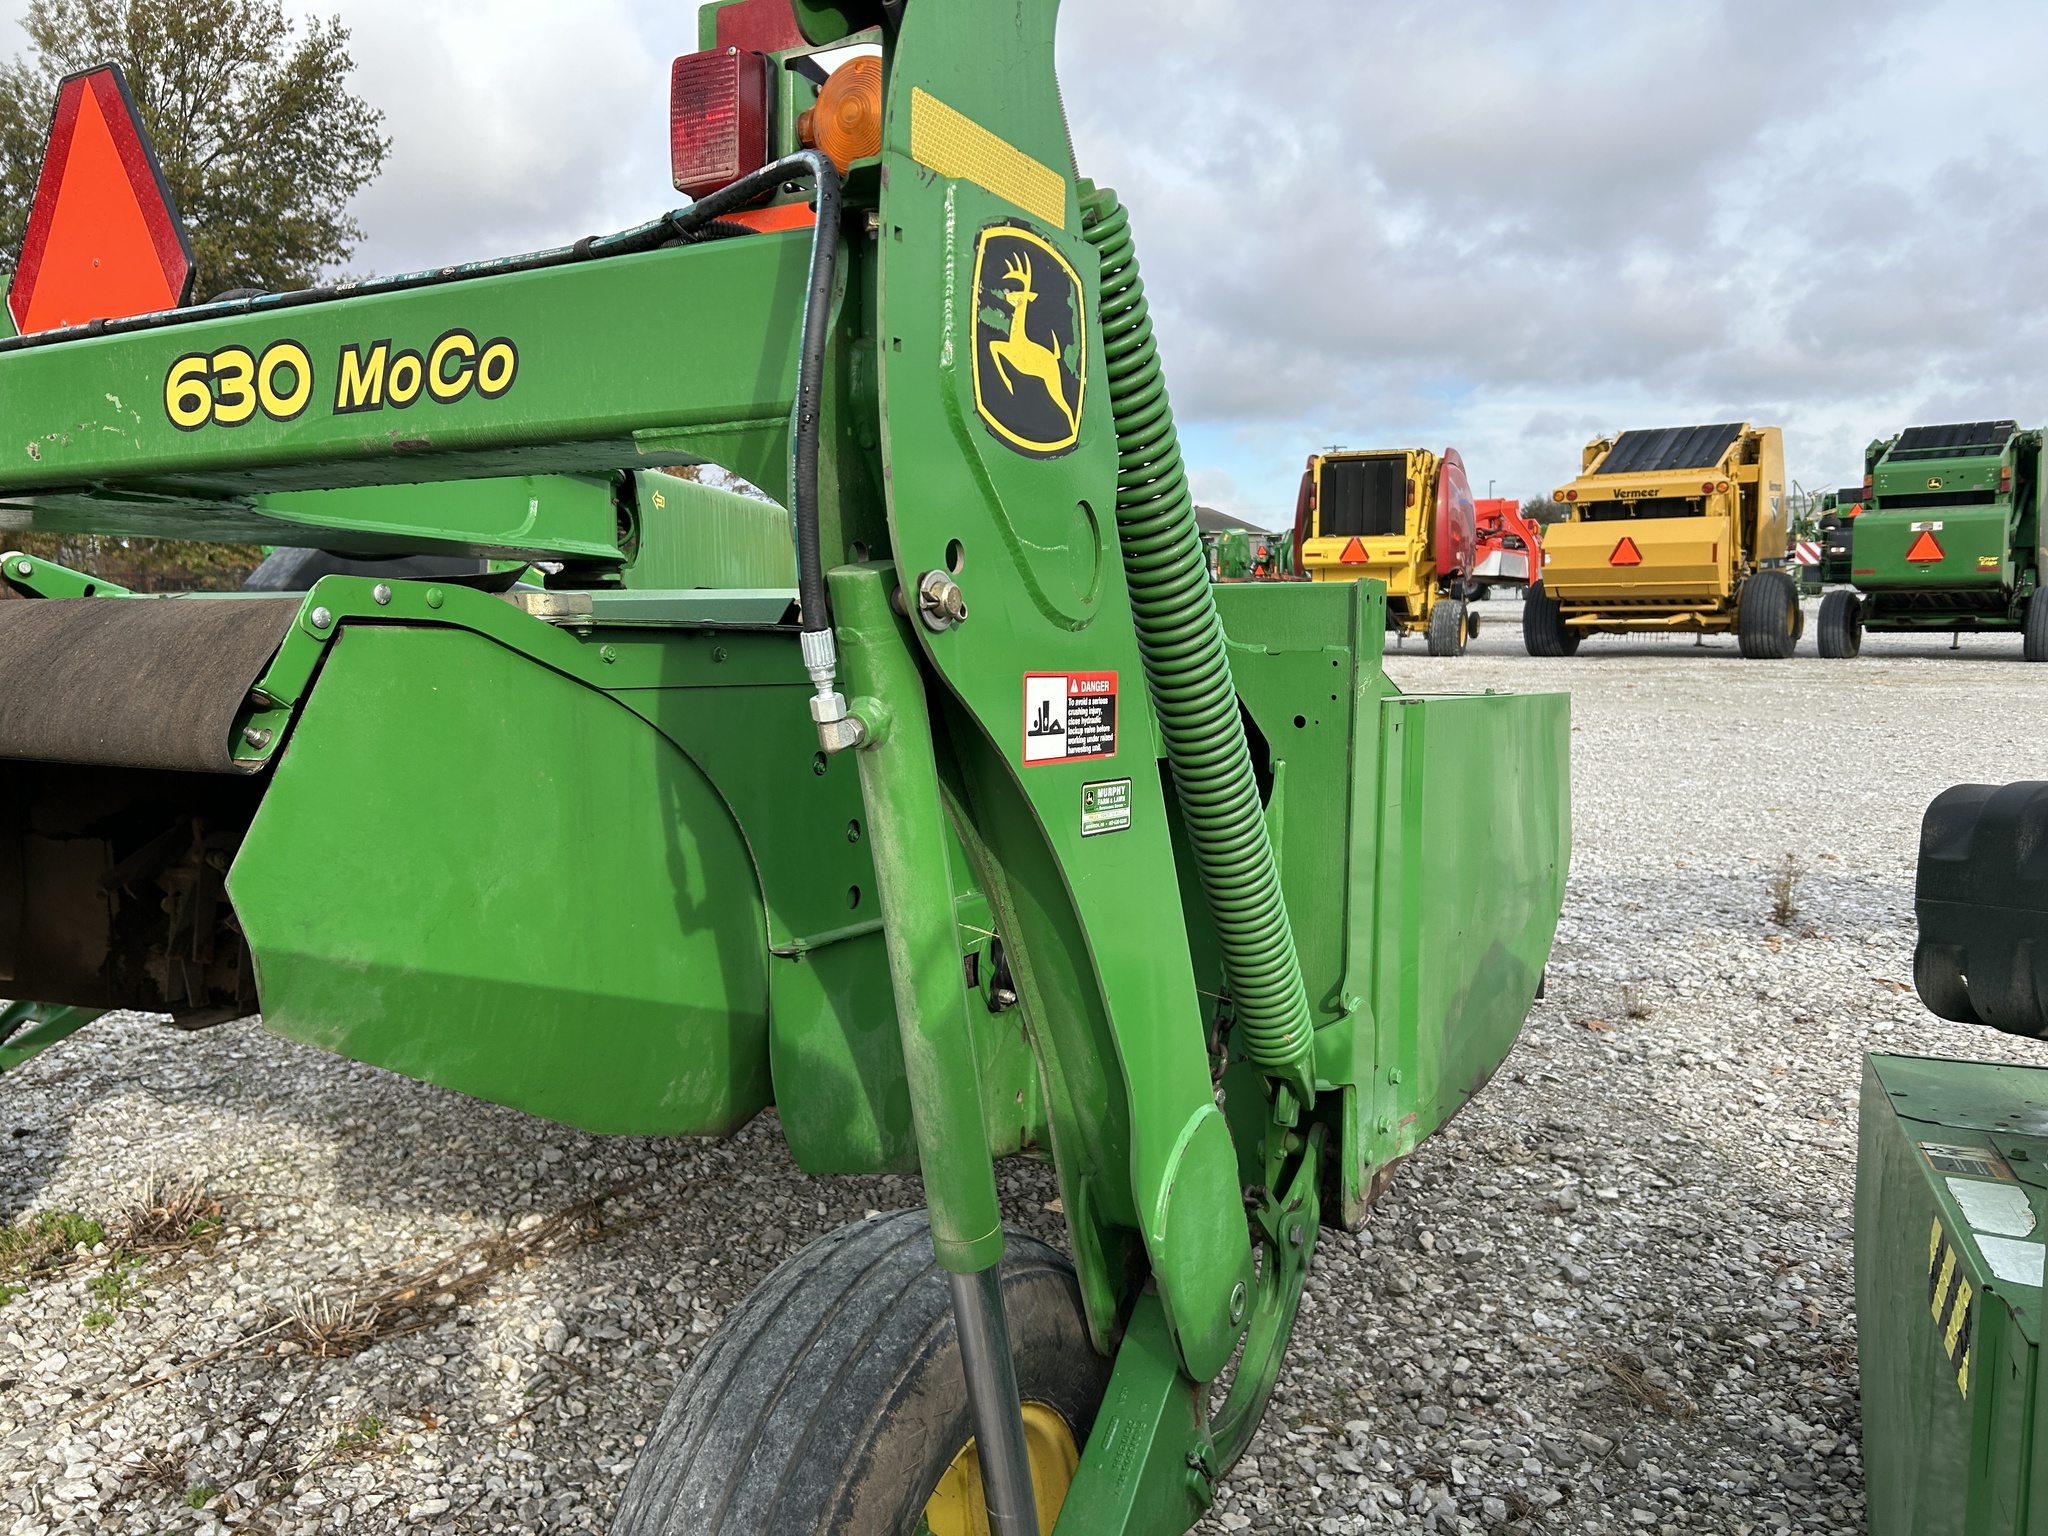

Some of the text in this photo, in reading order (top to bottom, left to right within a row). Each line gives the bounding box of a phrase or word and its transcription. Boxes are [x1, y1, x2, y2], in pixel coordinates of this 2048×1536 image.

[164, 328, 519, 431] 630 MoCo
[1613, 488, 1660, 498] Vermeer
[1081, 680, 1110, 692] DANGER
[1068, 698, 1075, 706] To
[1075, 697, 1088, 706] avoid
[1092, 697, 1108, 705] serious
[1068, 706, 1102, 717] crushing injury,
[1068, 716, 1102, 726] close hydraulic
[1068, 725, 1110, 736] lockup valve before
[1068, 733, 1113, 746] working under raised
[1068, 743, 1102, 754] harvesting unit.
[1097, 785, 1126, 798] MURPHY
[1098, 797, 1109, 805] FARM
